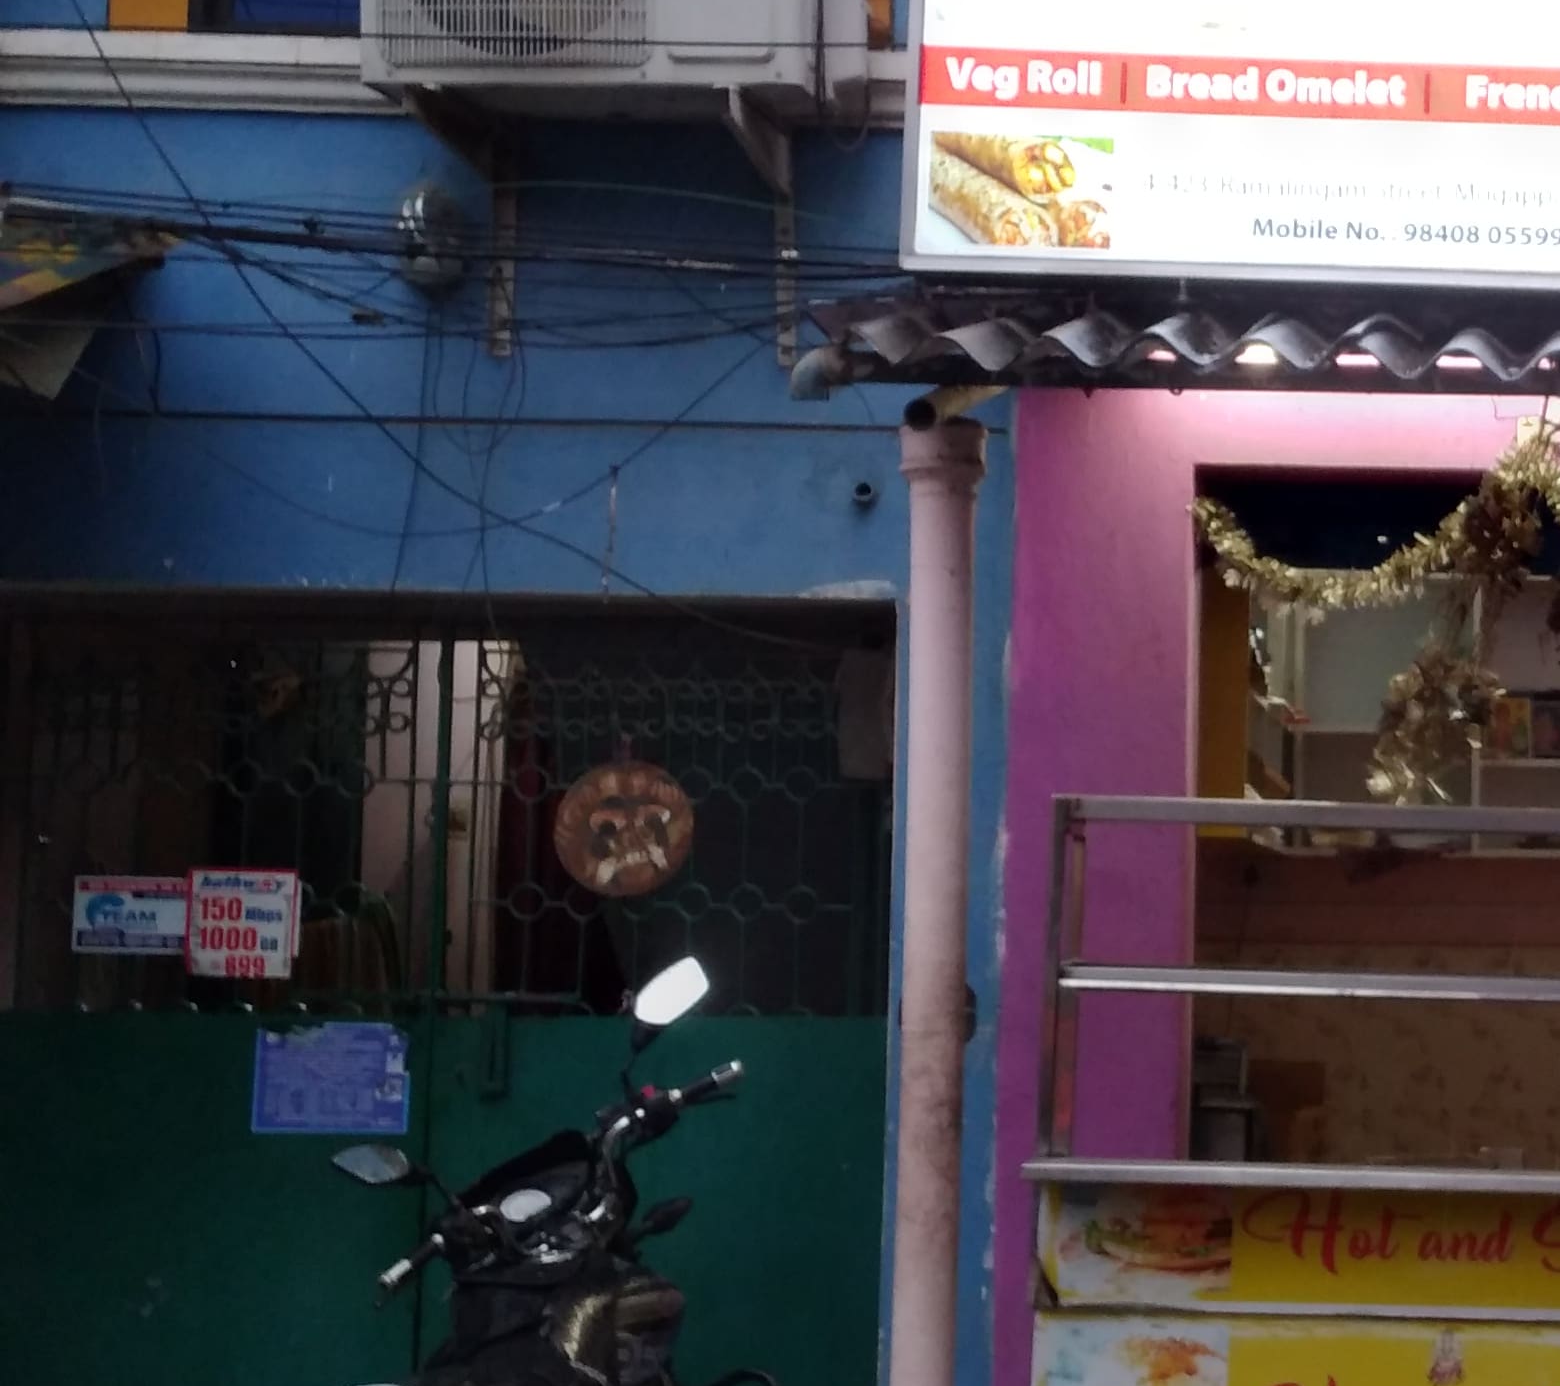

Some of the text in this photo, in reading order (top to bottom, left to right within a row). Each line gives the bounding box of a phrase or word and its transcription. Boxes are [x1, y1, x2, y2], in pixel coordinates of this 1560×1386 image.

[945, 57, 1019, 99] Veg
[1027, 60, 1102, 96] Roll
[1145, 64, 1258, 103] Bread
[1265, 69, 1406, 106] Omelet
[1252, 217, 1338, 240] Mobile
[1403, 223, 1481, 244] 98408
[201, 896, 243, 922] 150
[200, 926, 257, 951] 1000
[1239, 1187, 1411, 1276] Hot
[1417, 1198, 1514, 1263] and
